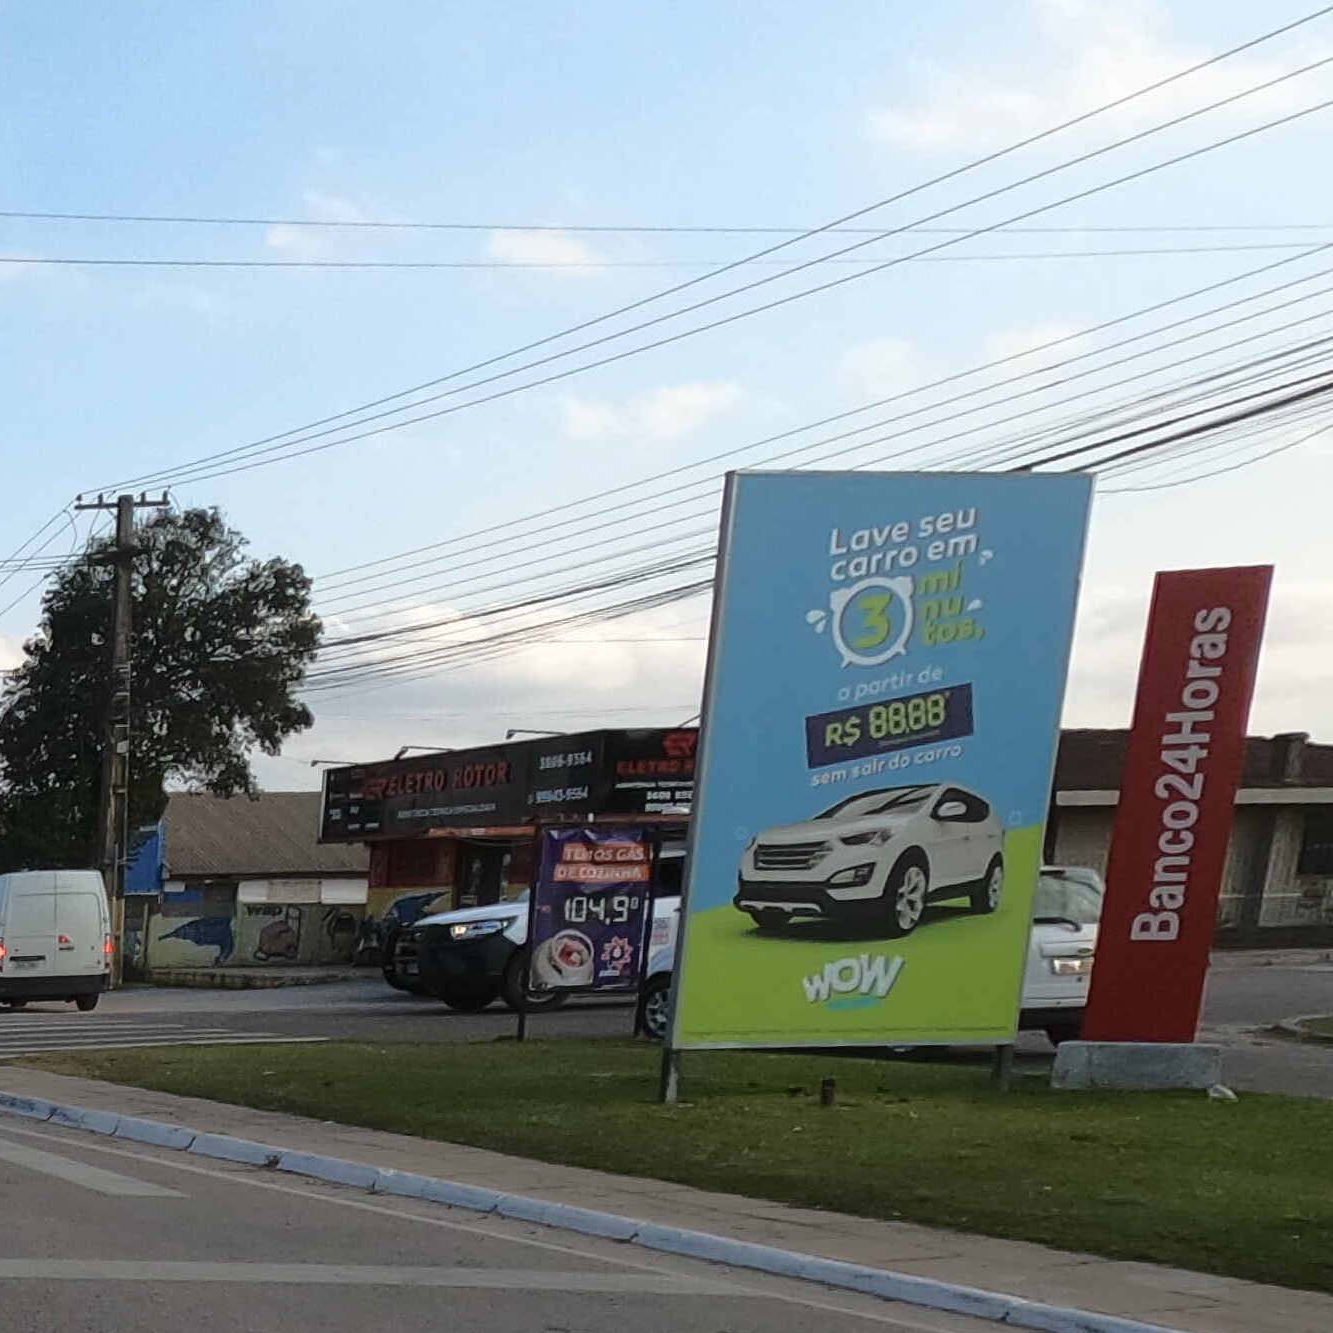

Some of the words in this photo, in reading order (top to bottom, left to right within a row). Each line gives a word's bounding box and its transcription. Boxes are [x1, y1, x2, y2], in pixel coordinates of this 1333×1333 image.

[830, 521, 910, 556] Lave
[918, 507, 976, 538] seu
[831, 546, 918, 581] carro
[926, 533, 978, 561] em
[853, 592, 894, 650] 3
[853, 670, 913, 700] partir
[917, 664, 944, 684] de
[825, 715, 862, 747] R$
[387, 769, 447, 796] ELETRO
[810, 769, 849, 787] sem
[851, 758, 886, 779] sair
[888, 752, 911, 770] do
[913, 744, 964, 765] carro
[1130, 605, 1233, 943] Banco24Horas
